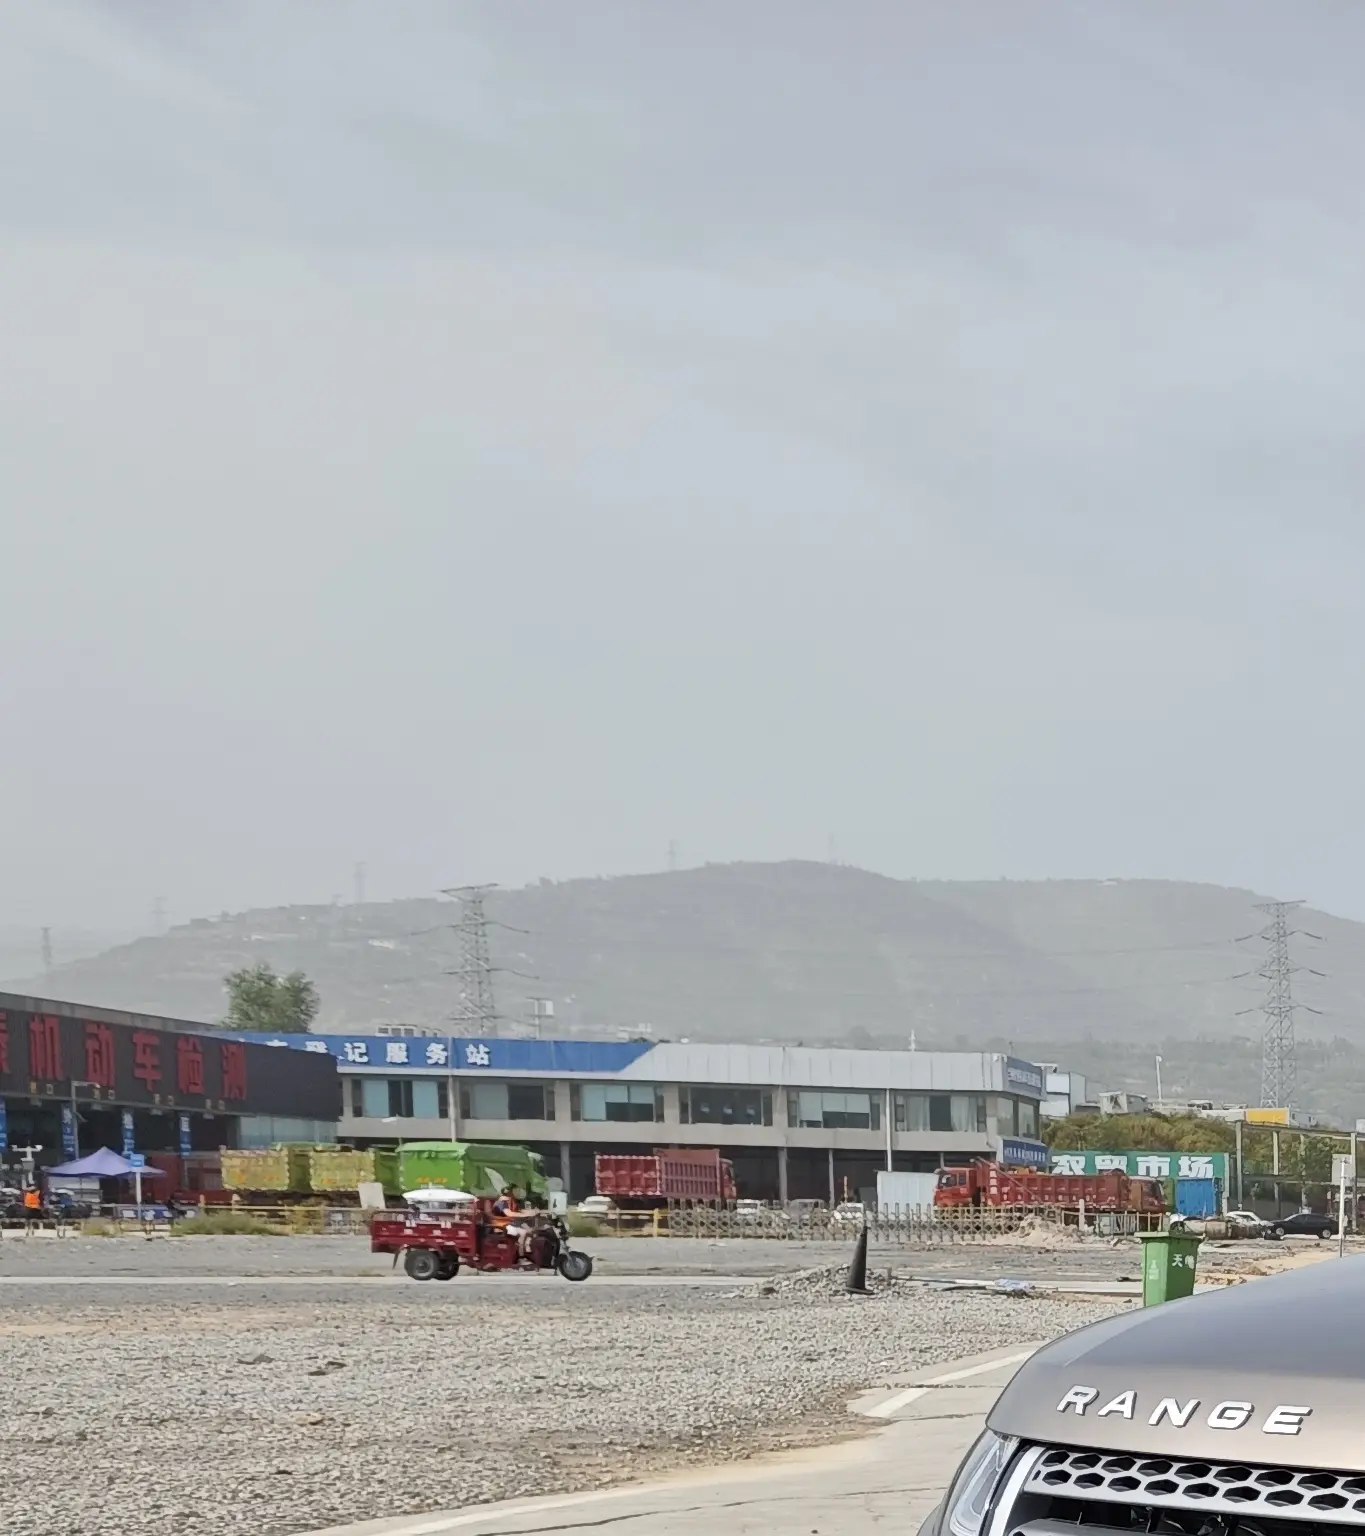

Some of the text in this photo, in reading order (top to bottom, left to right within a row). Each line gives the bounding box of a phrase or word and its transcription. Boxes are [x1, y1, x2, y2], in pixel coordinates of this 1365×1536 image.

[266, 1039, 490, 1066] 登记服务站
[1056, 1384, 1313, 1436] RANGE
